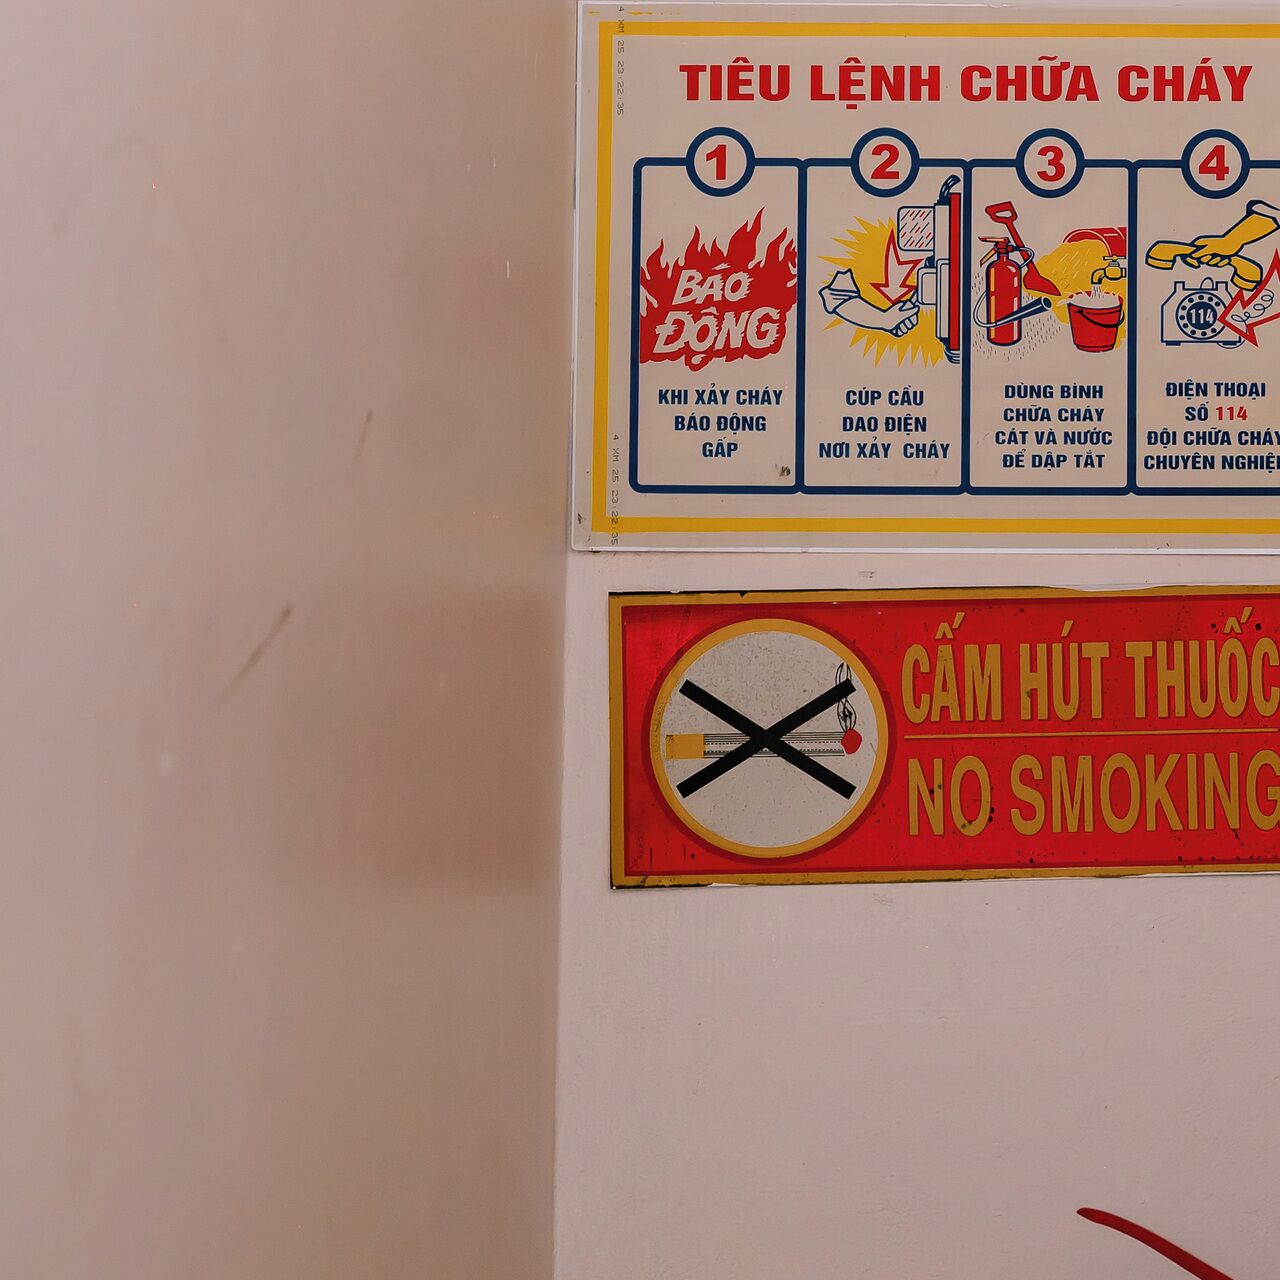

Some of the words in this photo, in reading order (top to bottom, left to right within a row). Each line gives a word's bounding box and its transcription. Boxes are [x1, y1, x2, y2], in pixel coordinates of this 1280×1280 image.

[679, 56, 791, 102] TIÊU
[810, 56, 941, 110] LỆNH
[960, 55, 1100, 102] CHỮA
[1117, 57, 1253, 102] CHÁY
[705, 144, 728, 181] 1
[870, 144, 900, 180] 2
[1037, 145, 1065, 182] 3
[1198, 144, 1230, 181] 4
[672, 263, 755, 305] BÁO
[1190, 308, 1214, 324] 114
[653, 306, 780, 365] ĐỘNG
[658, 389, 689, 405] KHI
[694, 382, 730, 405] XẢY
[735, 386, 783, 406] CHÁY
[845, 385, 882, 406] CÚP
[888, 384, 924, 406] CẦU
[1004, 381, 1054, 399] DÙNG
[1060, 382, 1104, 399] BÌNH
[1165, 379, 1208, 400] ĐIỆN
[1213, 382, 1266, 401] THOẠI
[1003, 404, 1052, 422] CHỮA
[1057, 405, 1105, 422] CHÁY
[1184, 401, 1209, 422] SỐ
[1215, 405, 1248, 421] 114
[674, 412, 711, 432] BÁO
[716, 412, 767, 435] ĐỘNG
[842, 416, 879, 433] DAO
[884, 413, 927, 436] ĐIỆN
[702, 436, 738, 458] GẤP
[818, 441, 850, 459] NƠI
[856, 436, 892, 459] XẢY
[903, 439, 950, 459] CHÁY
[995, 427, 1029, 445] CÁT
[1034, 428, 1058, 445] VÀ
[1063, 427, 1113, 446] NƯỚC
[1146, 427, 1177, 449] ĐỘI
[1183, 427, 1232, 446] CHỮA
[1002, 448, 1027, 468] ĐỂ
[1031, 451, 1068, 472] DẬP
[1073, 449, 1105, 469] TẮT
[1143, 451, 1215, 470] CHUYÊN
[901, 612, 1003, 724] CẤM
[1019, 619, 1110, 721] HÚT
[1125, 606, 1280, 719] THUỐC
[908, 755, 996, 836] NO
